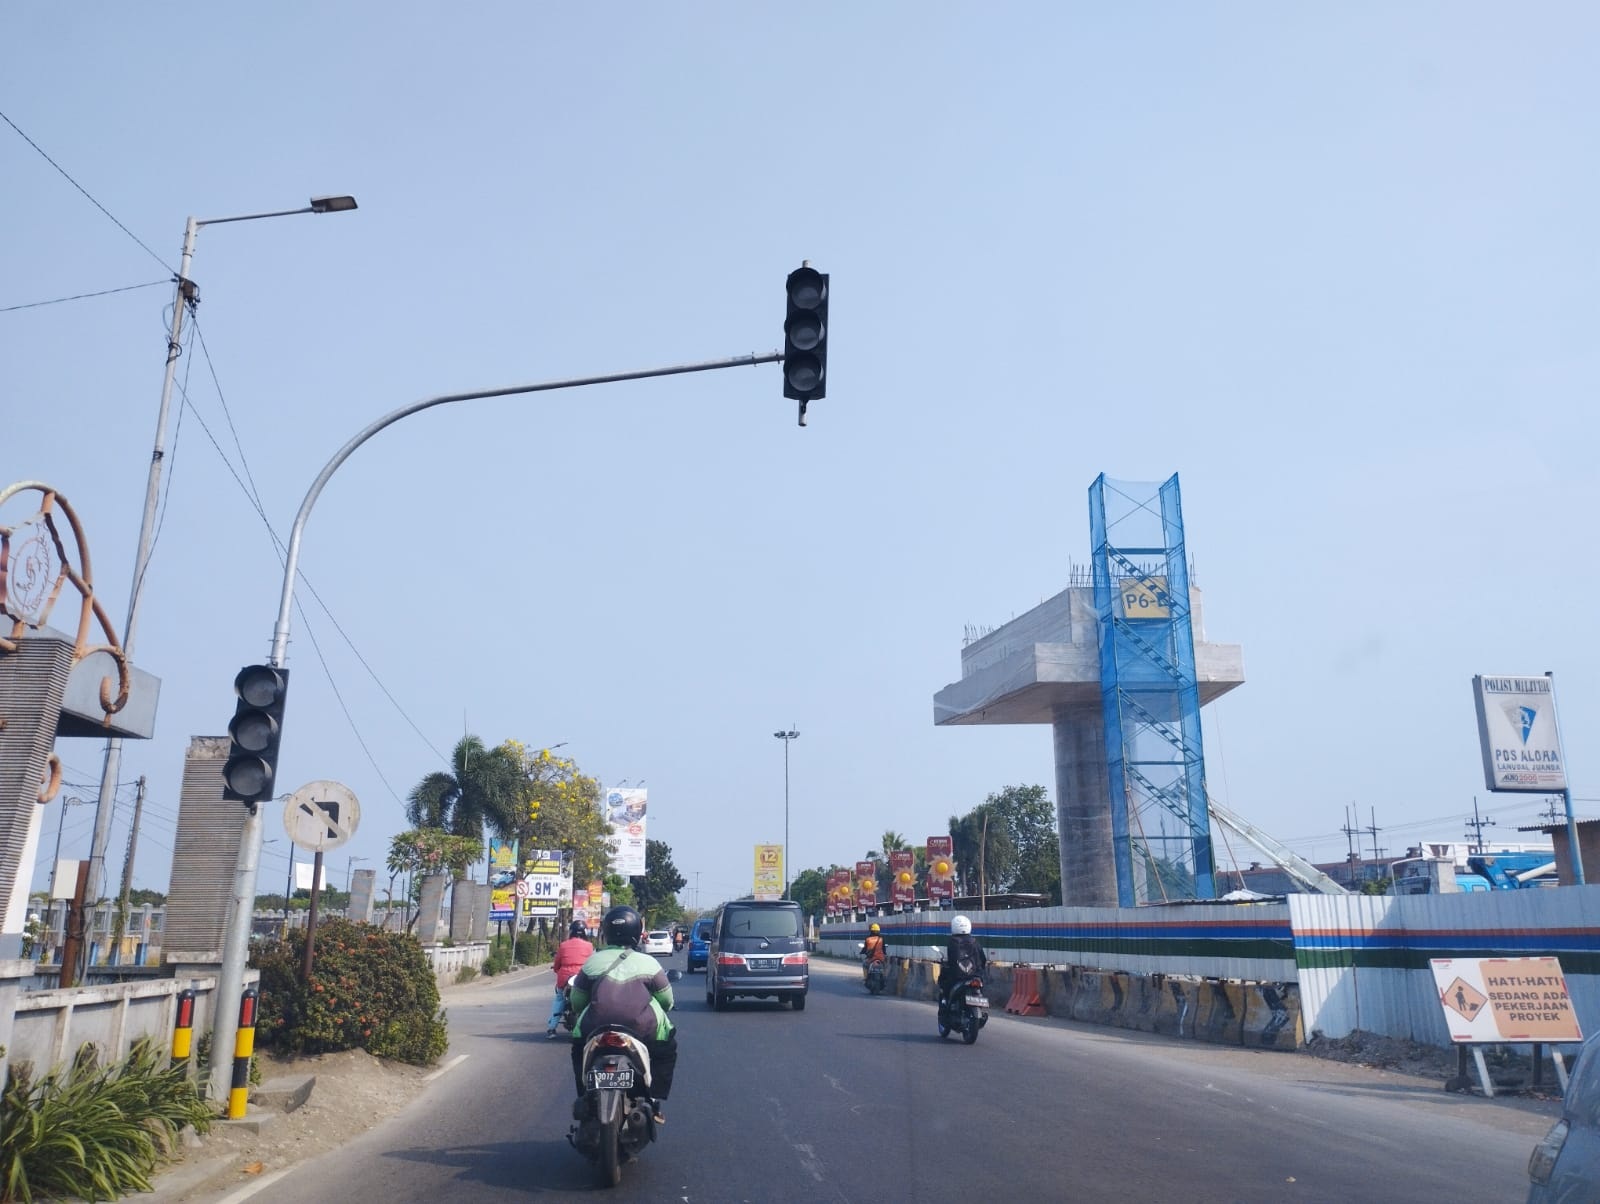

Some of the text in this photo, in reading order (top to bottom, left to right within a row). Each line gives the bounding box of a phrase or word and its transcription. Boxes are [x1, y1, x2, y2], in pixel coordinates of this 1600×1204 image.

[1484, 679, 1512, 692] POLISI
[1496, 749, 1517, 761] POS
[1488, 977, 1560, 986] HATI-HATI
[1488, 992, 1569, 1000] SEDANG ADA
[1495, 1002, 1569, 1011] PEKERJAAN
[1510, 1012, 1561, 1021] PROYEK
